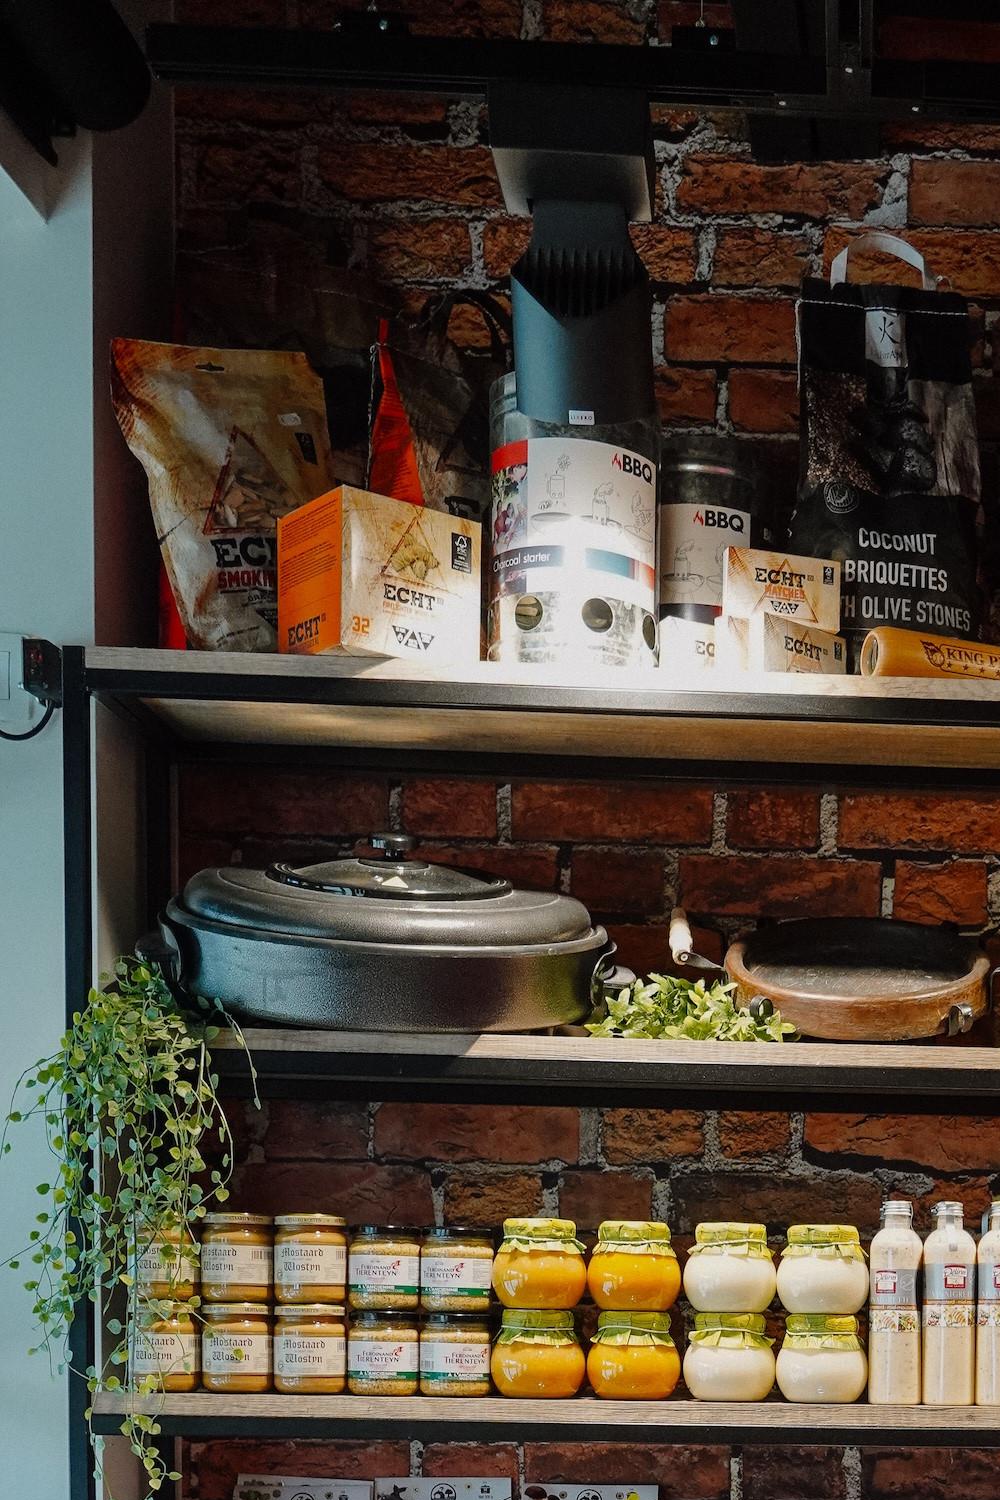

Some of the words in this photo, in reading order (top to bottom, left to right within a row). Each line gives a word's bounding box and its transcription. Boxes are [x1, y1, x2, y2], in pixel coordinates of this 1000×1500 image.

[879, 316, 901, 343] 火
[622, 453, 653, 486] BBQ
[704, 510, 744, 534] BBQ
[858, 527, 937, 555] COCONUT
[210, 537, 275, 568] EC
[493, 553, 521, 573] Charcoal
[523, 552, 551, 564] starter
[218, 570, 275, 590] SMOKIN
[755, 567, 806, 588] ECHT
[844, 559, 948, 593] BRIQUETTES
[384, 583, 435, 611] ECHT
[764, 584, 805, 600] MATCHES
[861, 595, 911, 621] OLIVE
[916, 600, 971, 632] STONES
[288, 615, 320, 646] ECHT
[352, 616, 370, 634] 32
[784, 635, 822, 661] ECHT
[946, 647, 984, 665] KING
[281, 1247, 324, 1258] Mostaard
[284, 1261, 320, 1273] Wostyn
[283, 1339, 326, 1350] Mostaard
[285, 1353, 323, 1364] Wostyn
